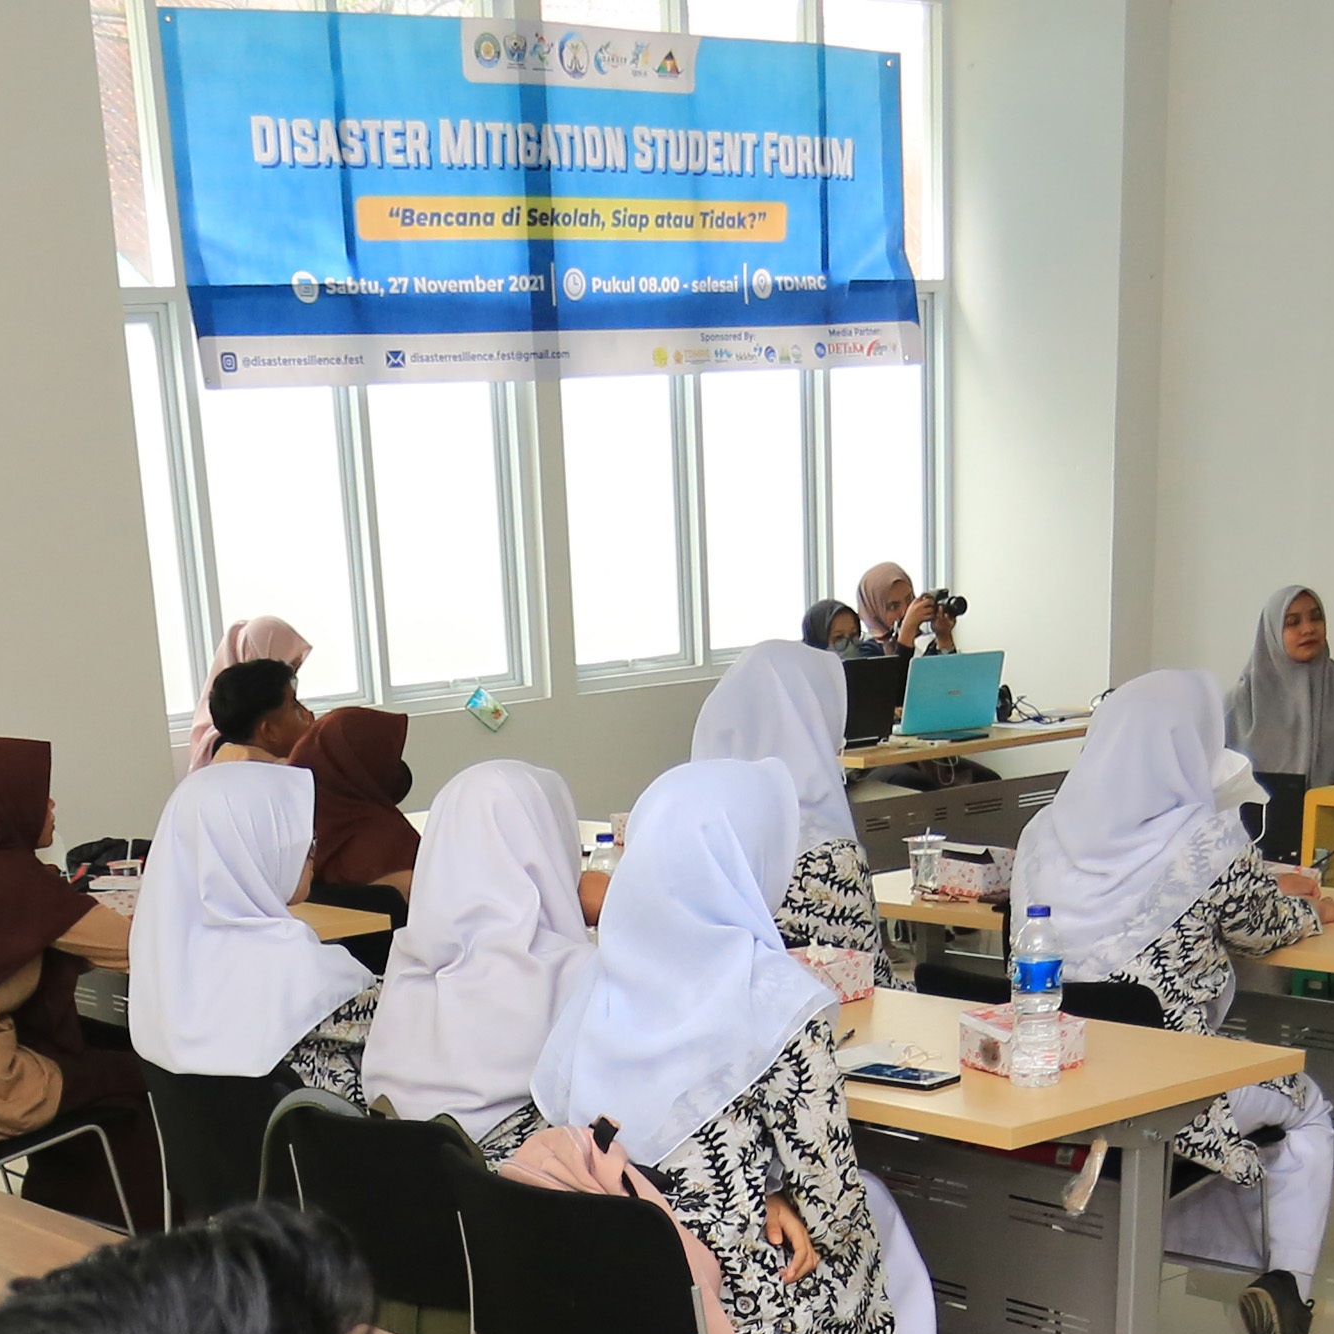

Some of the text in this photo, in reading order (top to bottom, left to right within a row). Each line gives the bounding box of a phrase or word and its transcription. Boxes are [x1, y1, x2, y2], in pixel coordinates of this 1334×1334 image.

[250, 115, 855, 180] DISASTER MITIGATION STUDENT FORUM
[389, 206, 494, 227] “Bencana
[502, 206, 520, 227] di
[527, 207, 606, 230] Sekolah,
[612, 209, 649, 232] Siap
[655, 211, 694, 229] atau
[325, 274, 545, 297] Sabtu, 27 November 2021
[591, 275, 635, 293] Pukul
[639, 275, 679, 293] 08.00
[691, 274, 738, 293] selesai
[775, 274, 827, 292] TDMRC
[700, 331, 743, 345] Sponsored
[828, 328, 852, 338] Media
